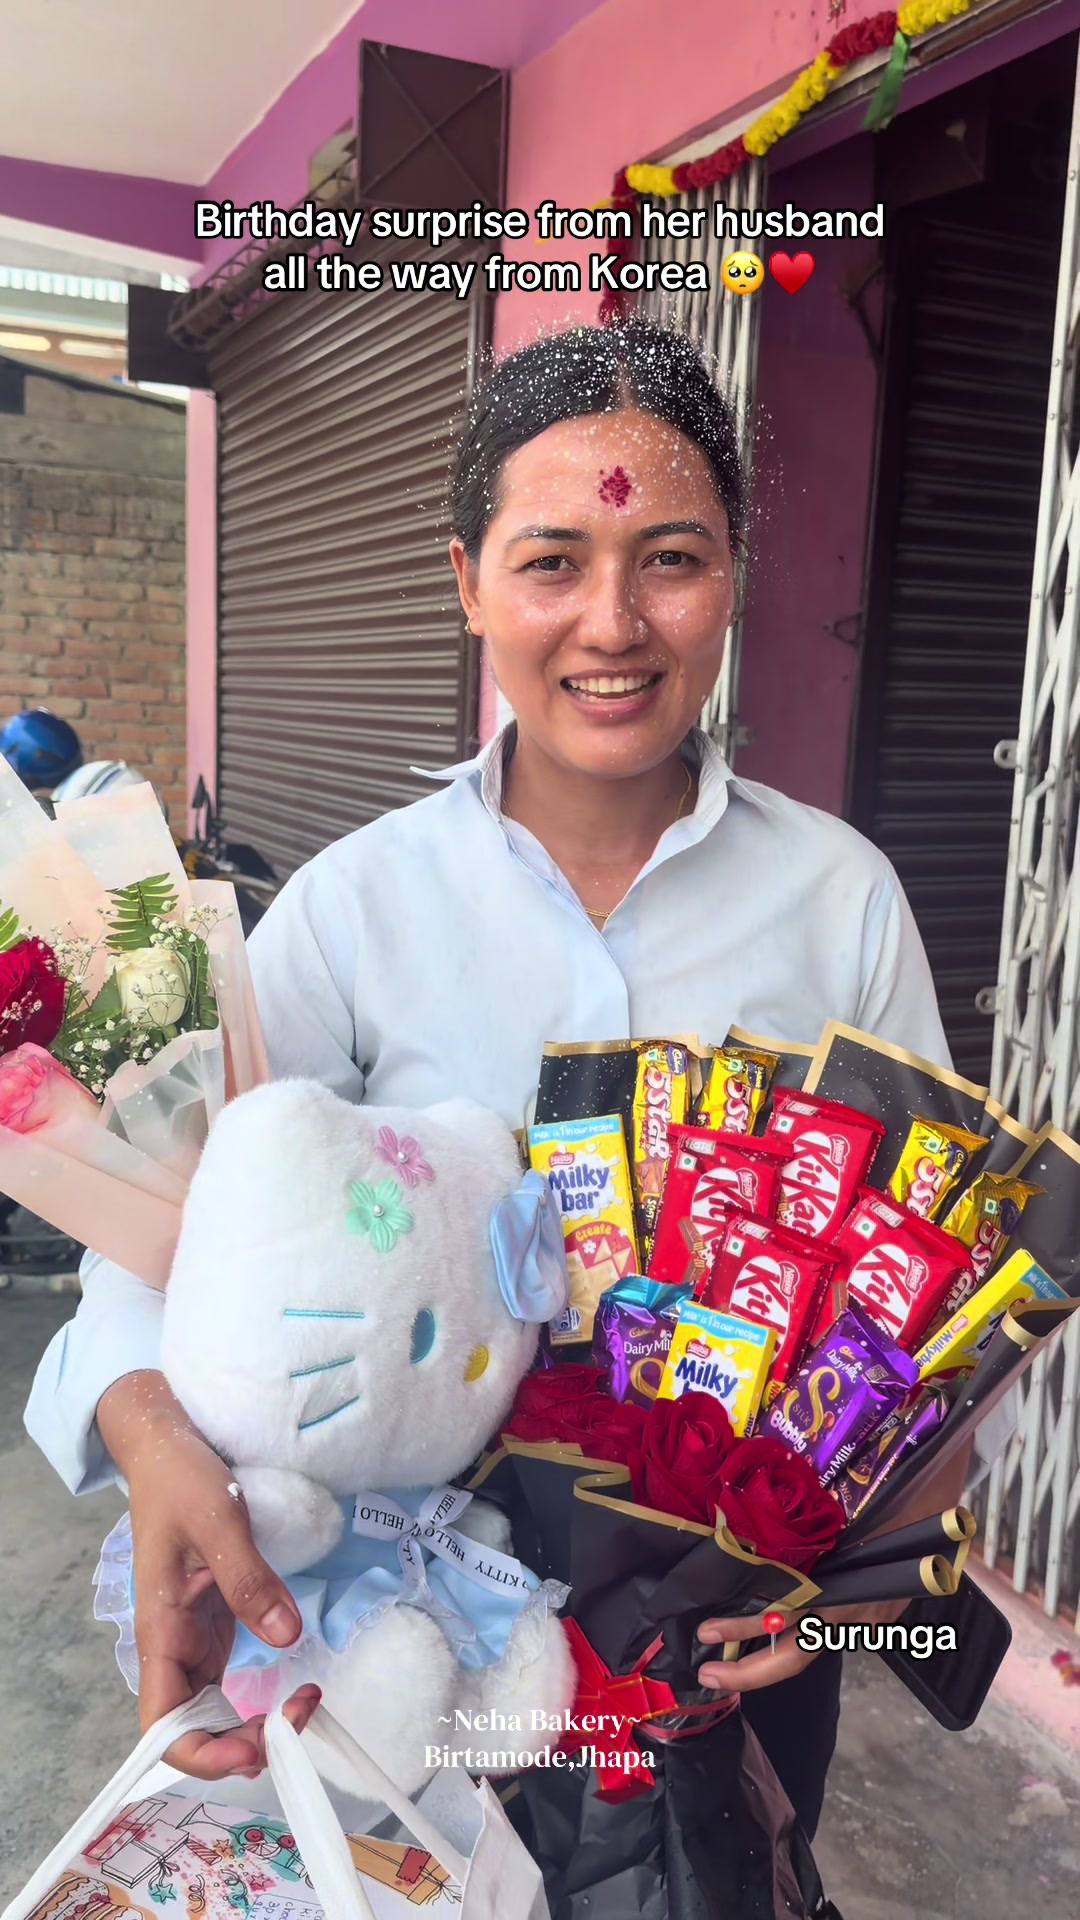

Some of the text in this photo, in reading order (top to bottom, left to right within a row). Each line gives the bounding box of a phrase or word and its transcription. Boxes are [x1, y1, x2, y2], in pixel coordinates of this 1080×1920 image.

[548, 1164, 610, 1191] Milky
[560, 1188, 600, 1212] bar
[575, 1223, 613, 1242] Create
[683, 1310, 699, 1322] Milk
[719, 1322, 735, 1333] our
[735, 1327, 760, 1342] recipe
[624, 1341, 653, 1357] Dairy
[675, 1356, 739, 1399] Milky
[826, 1349, 859, 1384] Dairy Milk
[792, 1403, 812, 1427] SILK
[770, 1409, 807, 1454] Bubbly
[831, 1442, 857, 1469] Milk
[360, 1506, 405, 1531] HELLO
[424, 1526, 466, 1562] HELLO
[474, 1560, 520, 1587] KITTY
